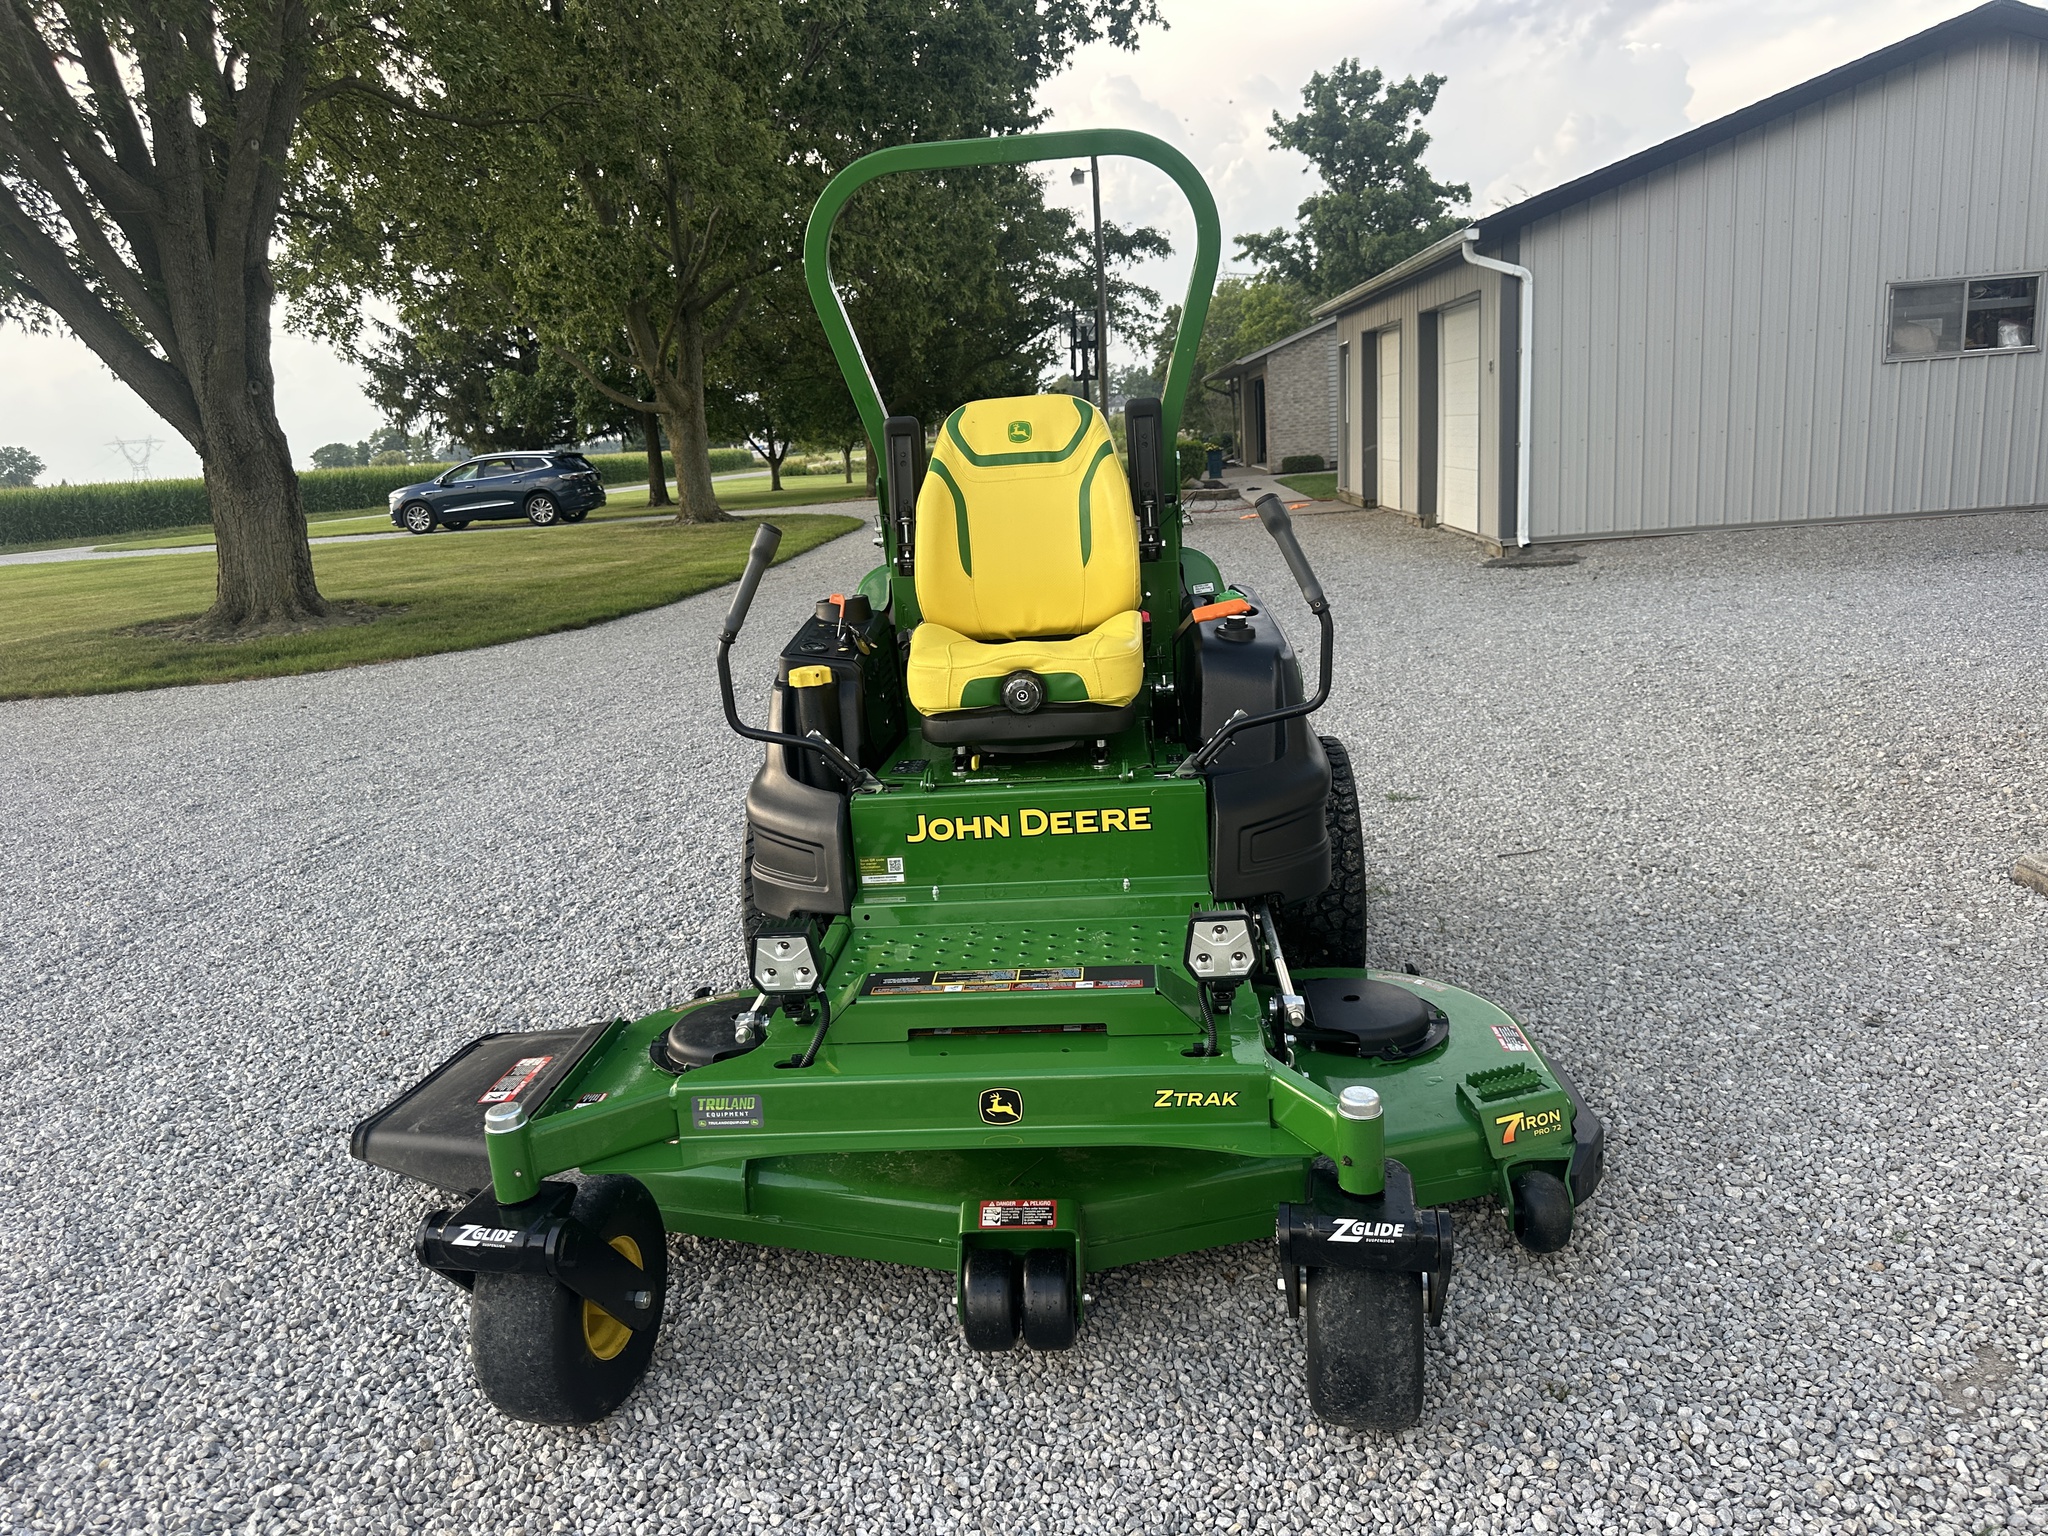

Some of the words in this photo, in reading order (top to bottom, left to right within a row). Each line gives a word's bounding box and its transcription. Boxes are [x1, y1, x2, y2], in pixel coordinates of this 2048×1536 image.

[906, 814, 1011, 843] JOHN
[1018, 806, 1152, 837] DEERE
[697, 1097, 756, 1111] TRULAND
[1154, 1089, 1240, 1107] ZTRAK
[1533, 1127, 1550, 1137] PRO
[1552, 1124, 1562, 1132] 72
